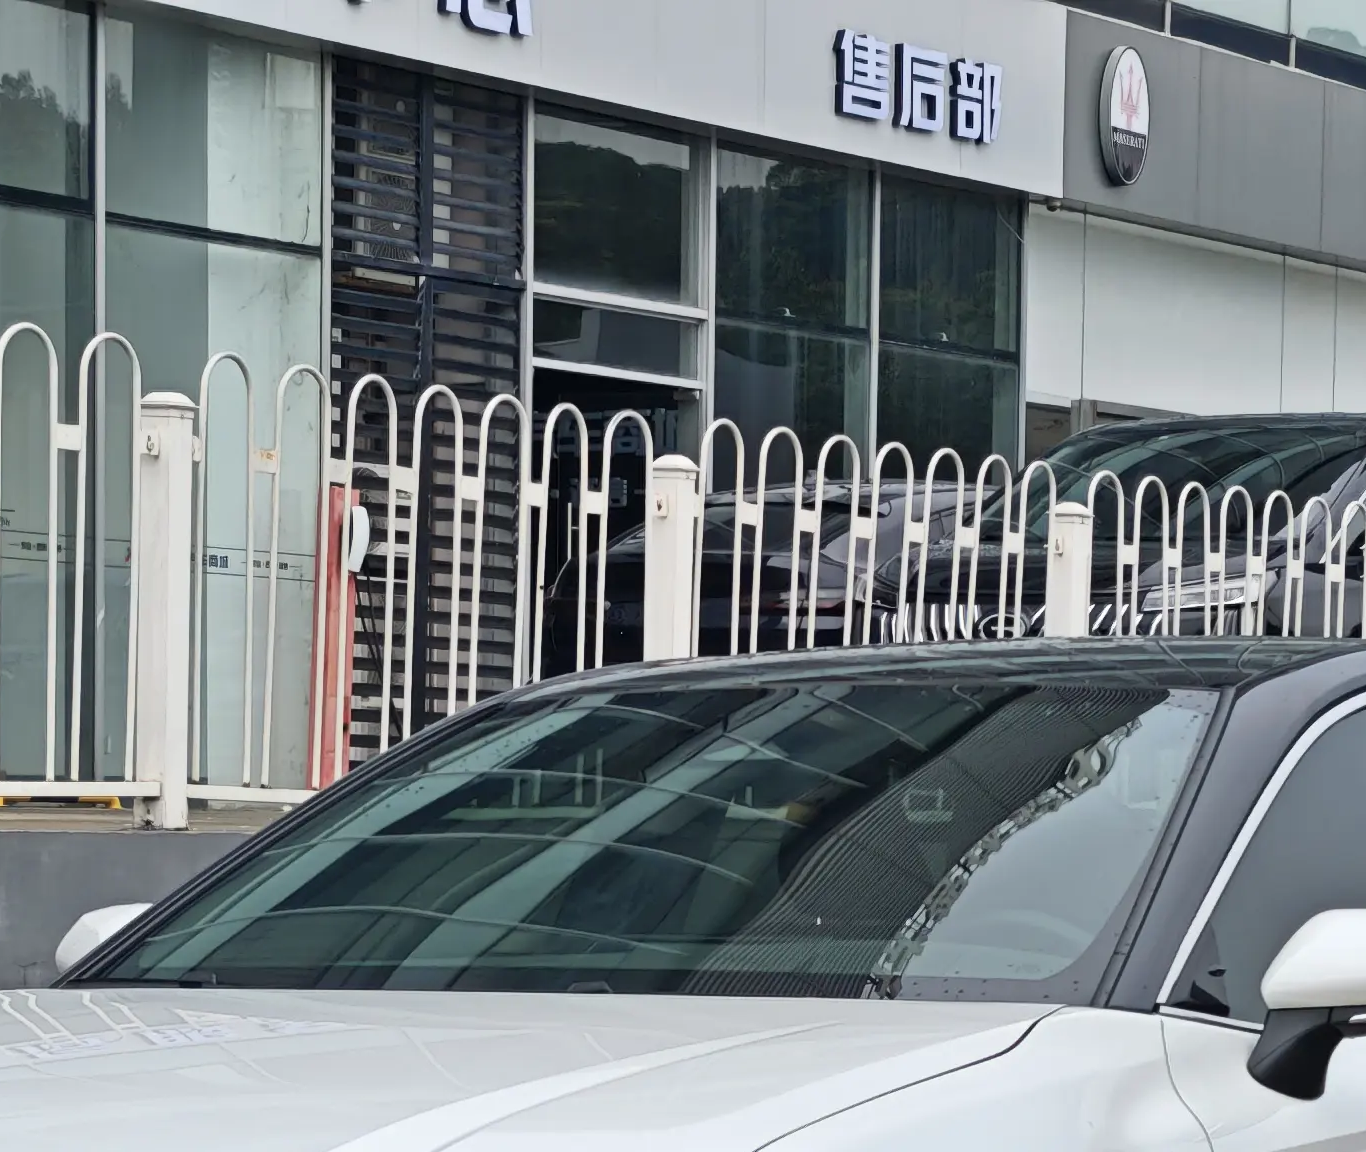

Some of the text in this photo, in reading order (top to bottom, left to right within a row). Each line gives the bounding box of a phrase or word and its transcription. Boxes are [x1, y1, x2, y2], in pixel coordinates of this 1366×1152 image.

[832, 28, 1003, 144] 售后部
[1113, 131, 1145, 149] MASERATI
